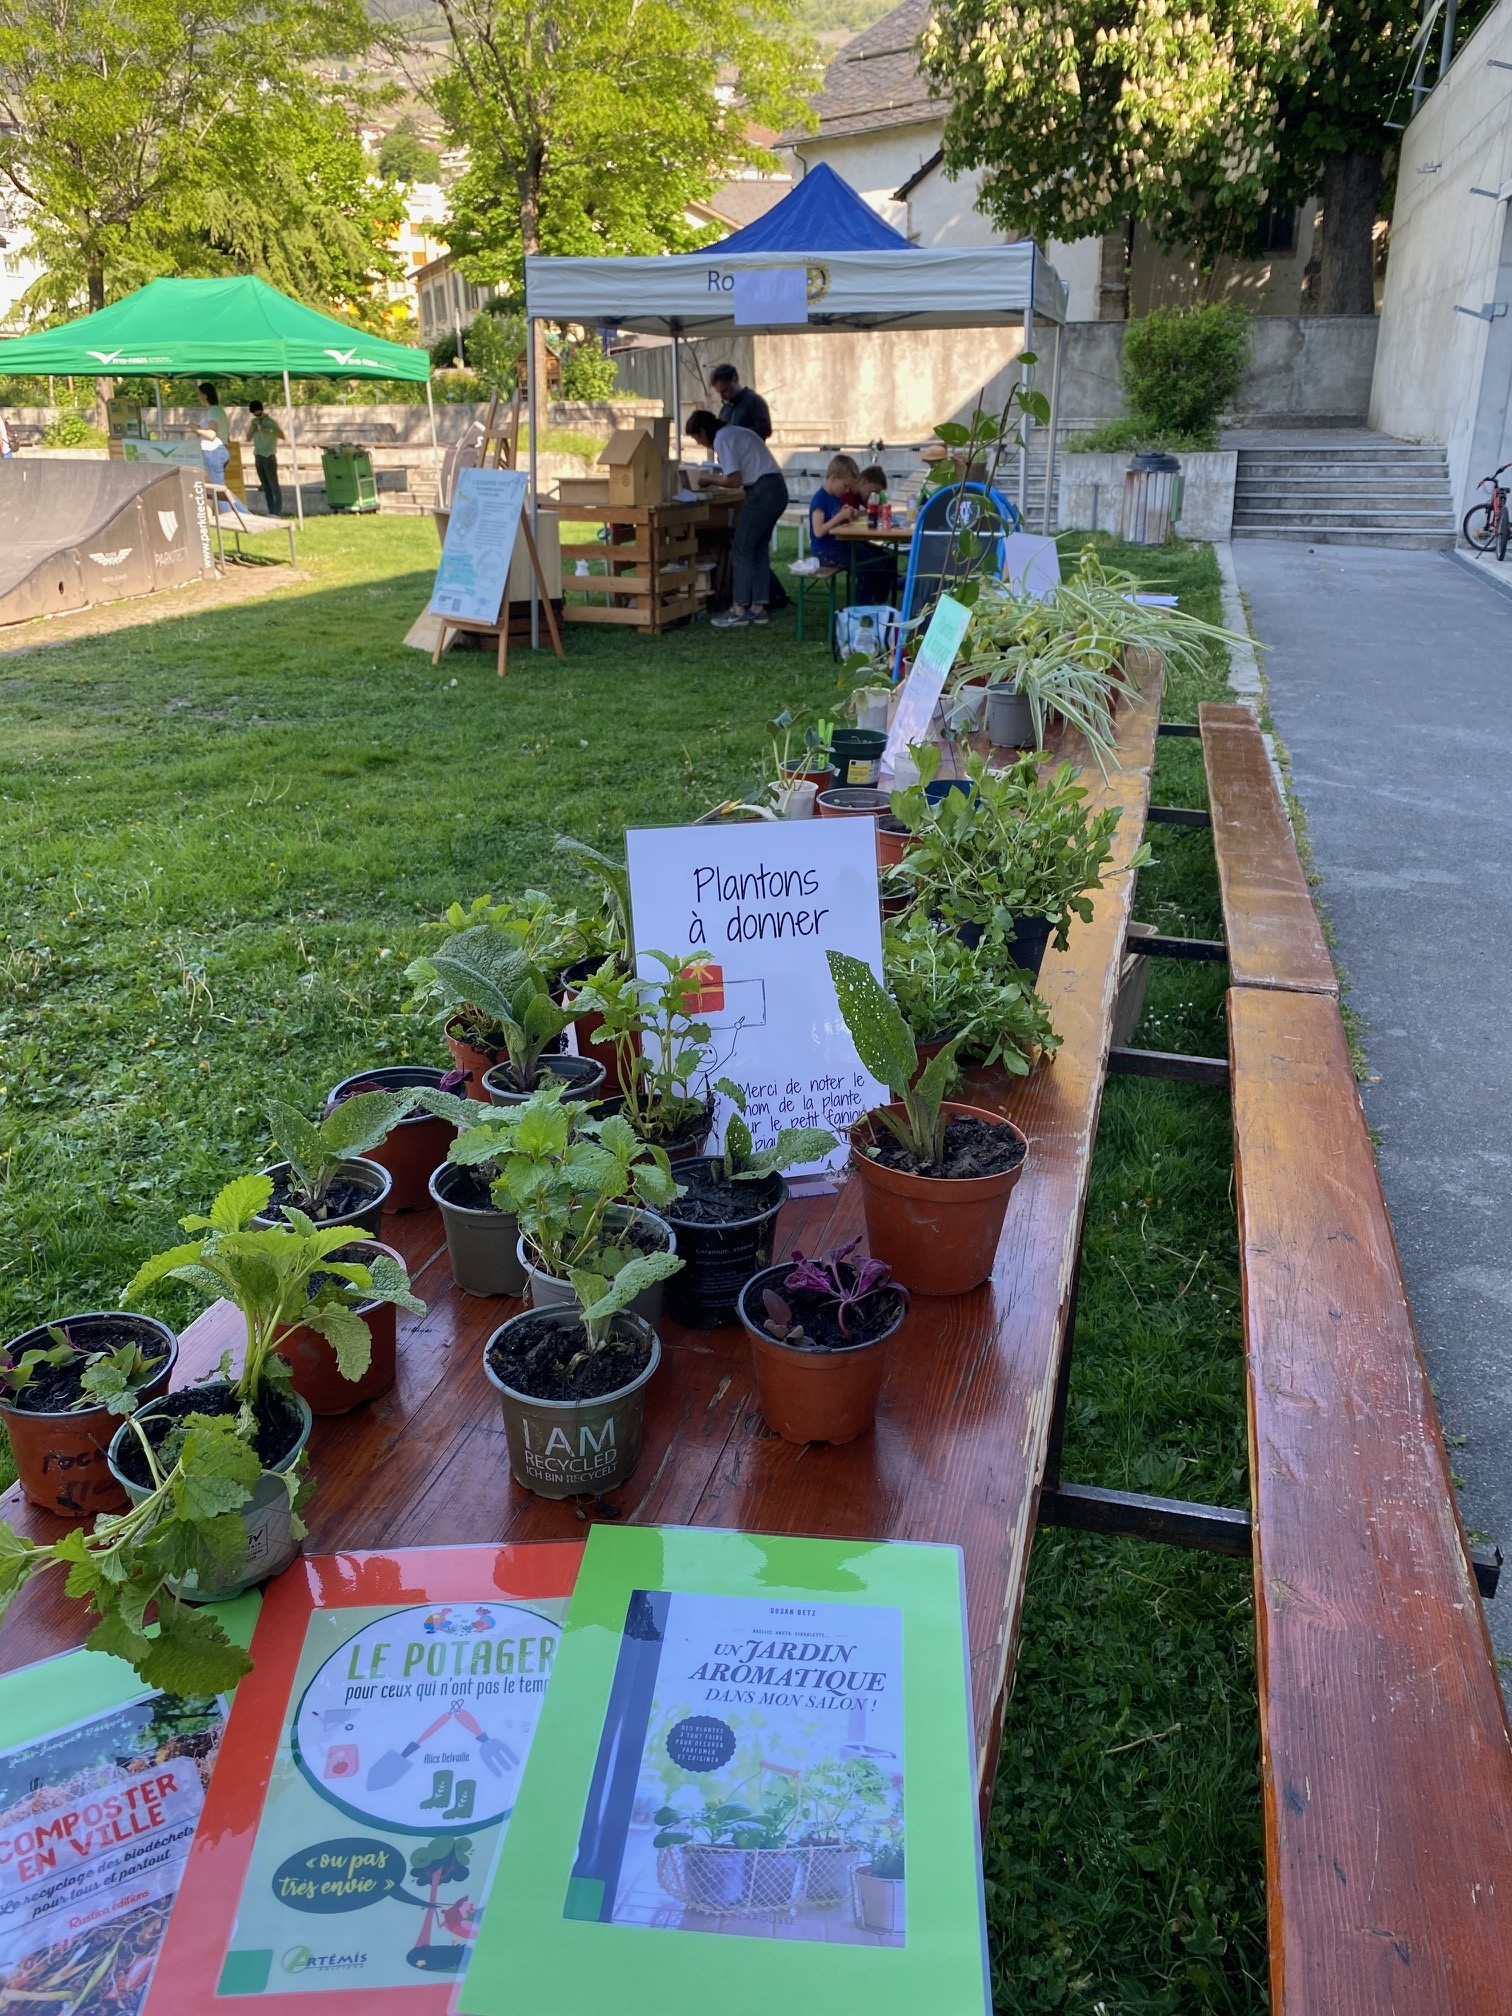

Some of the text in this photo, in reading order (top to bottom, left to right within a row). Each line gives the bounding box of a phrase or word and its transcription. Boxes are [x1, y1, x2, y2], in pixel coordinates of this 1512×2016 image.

[693, 863, 819, 902] Plantons
[688, 905, 829, 944] à donner
[738, 1072, 864, 1099] Merci de noter le
[743, 1090, 862, 1117] nom de la plante
[746, 1120, 761, 1134] ur
[770, 1116, 782, 1131] le
[790, 1111, 820, 1129] petit
[522, 1417, 616, 1457] I AM
[525, 1449, 617, 1473] RECYCLED
[526, 1462, 618, 1483] ICH BIN RECYCELT
[770, 1607, 794, 1616] SUSAN
[347, 1636, 557, 1680] LE POTAGER
[714, 1639, 857, 1664] UN JARDIN
[345, 1684, 378, 1706] pour
[381, 1682, 412, 1698] ceux
[416, 1680, 436, 1702] qui
[440, 1677, 472, 1696] n'ont
[476, 1679, 500, 1700] pas
[504, 1676, 515, 1694] le
[688, 1662, 886, 1696] AROMATIQUE
[705, 1688, 756, 1704] DANS
[758, 1692, 803, 1707] MON
[806, 1695, 868, 1711] SALON
[424, 1752, 470, 1764] Alice Delvaille
[0, 1773, 178, 1864] COMPOSTER
[17, 1802, 166, 1883] EN VILLE
[23, 1869, 94, 1905] recyclage
[98, 1858, 122, 1874] des
[124, 1826, 195, 1862] biodéchets
[319, 1853, 348, 1869] ou
[347, 1850, 390, 1880] pas
[32, 1850, 171, 1919] pour tous et partout
[278, 1876, 318, 1899] très
[320, 1876, 377, 1896] envie
